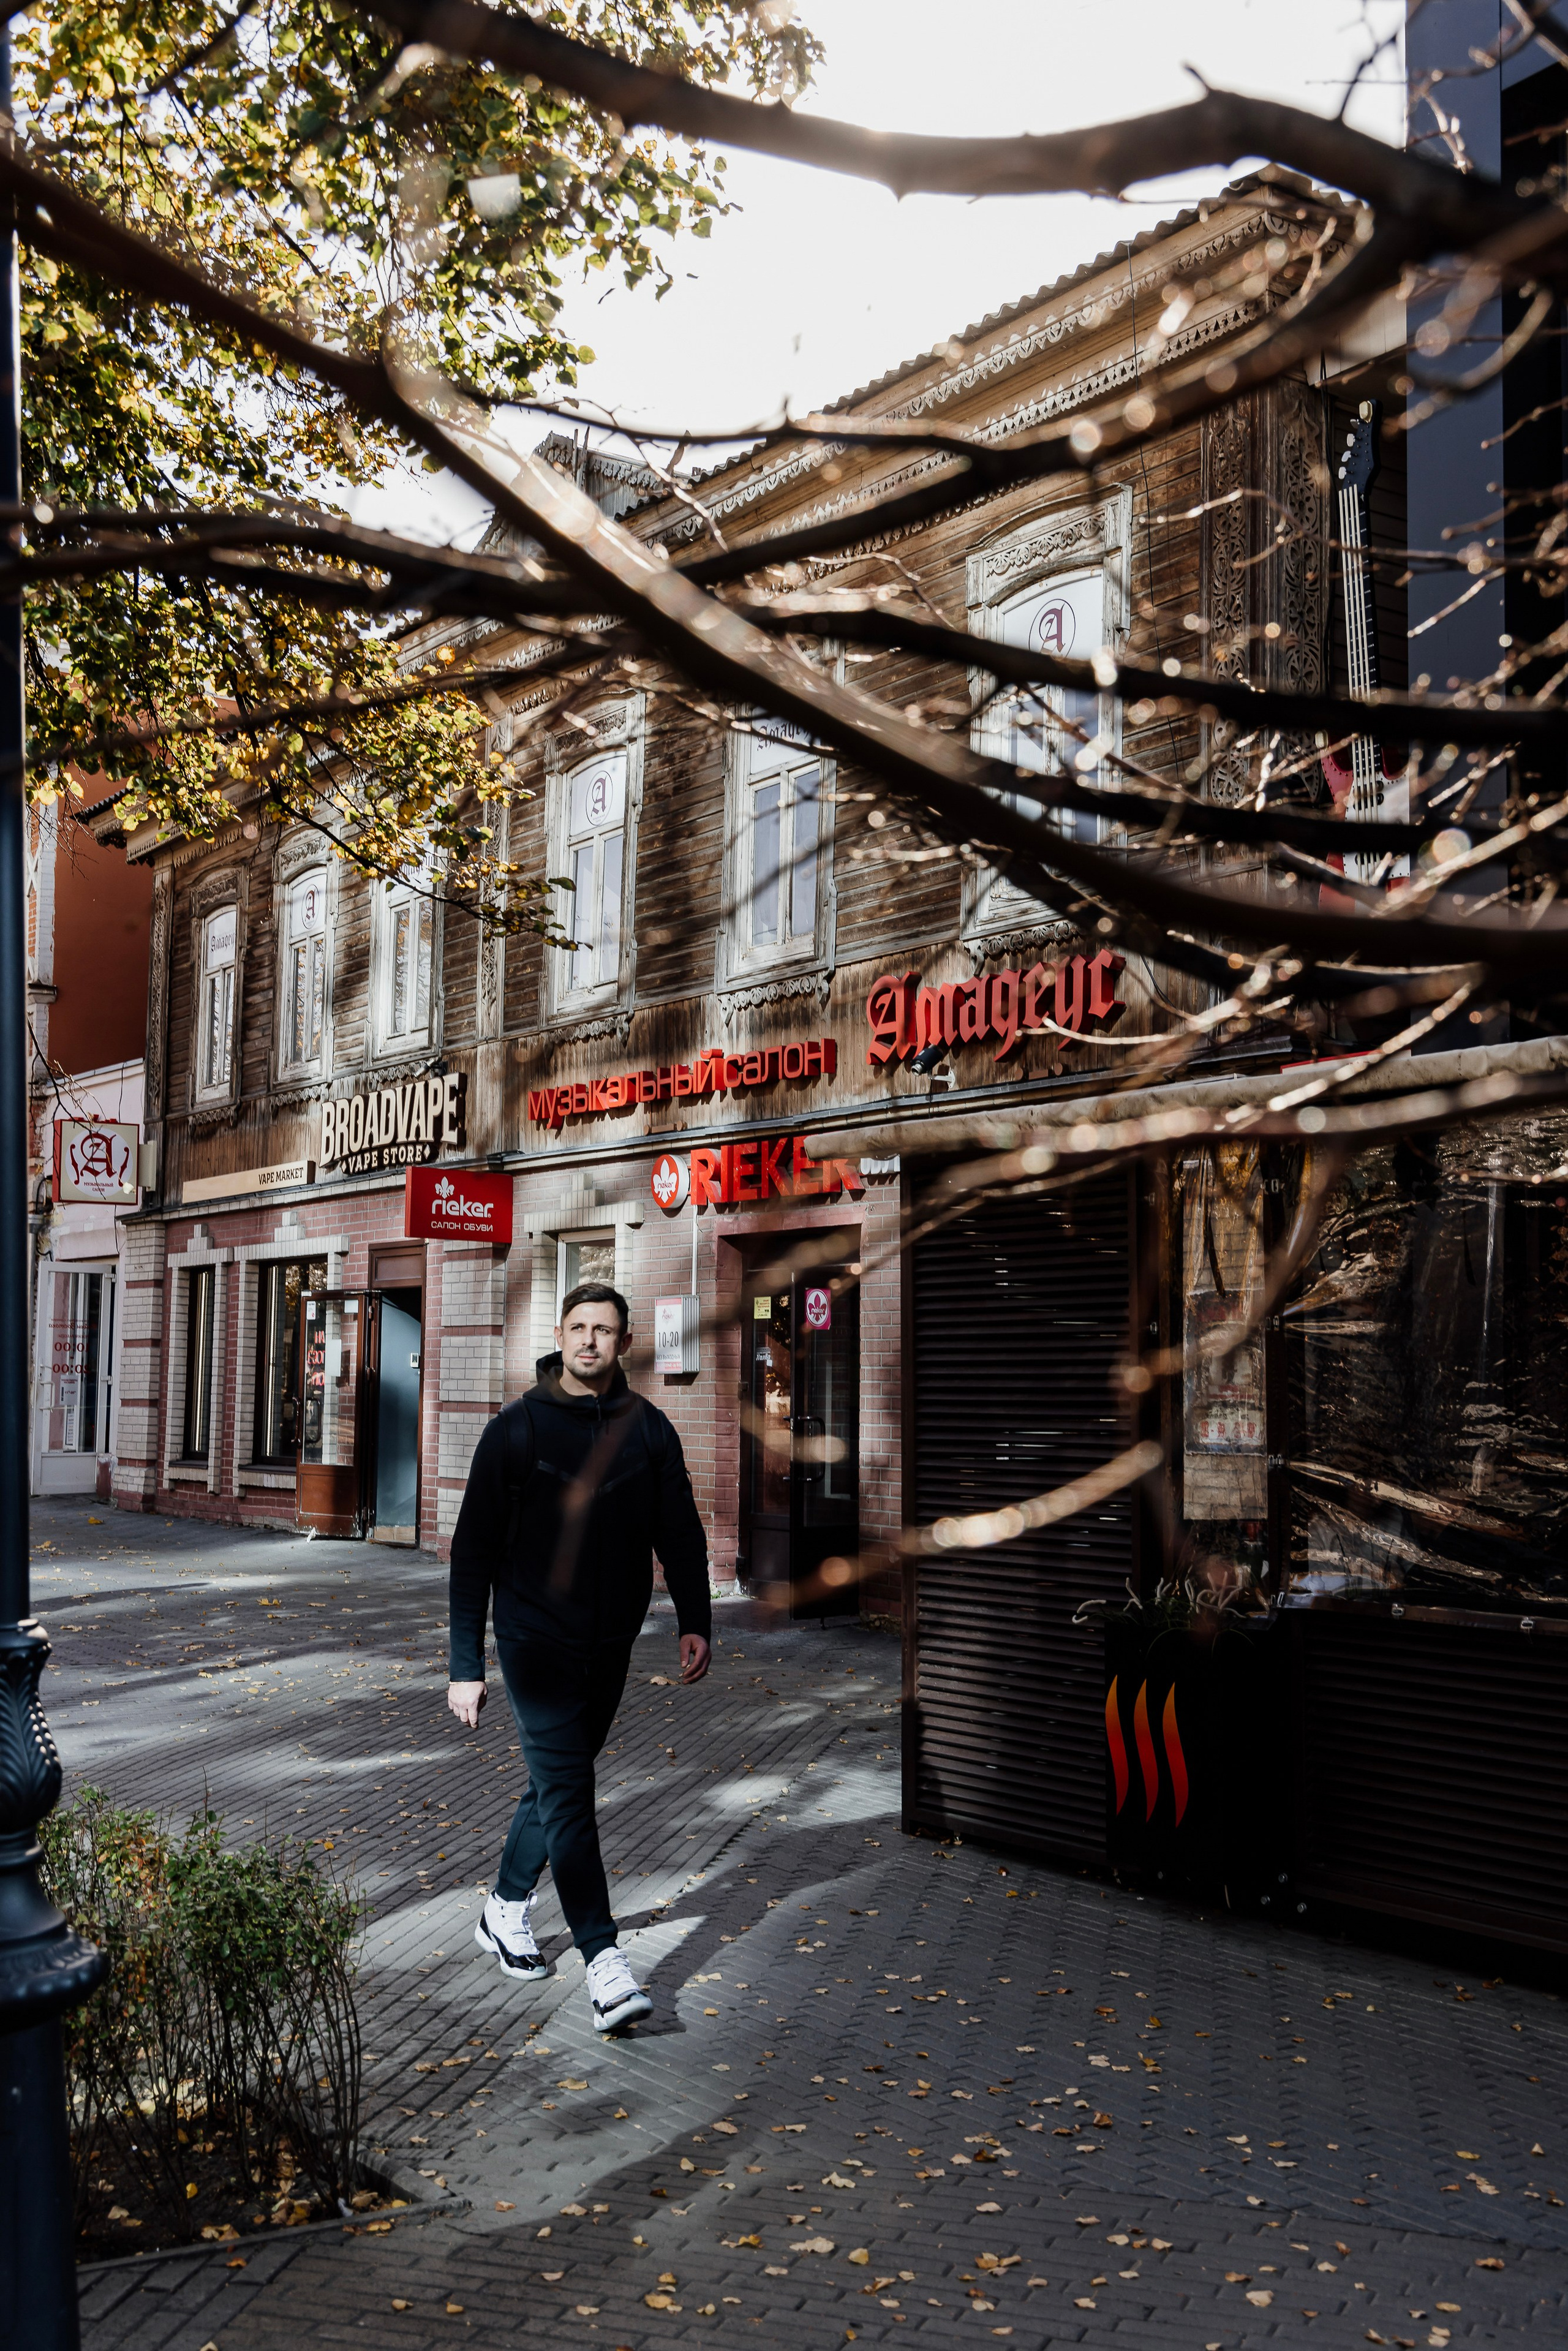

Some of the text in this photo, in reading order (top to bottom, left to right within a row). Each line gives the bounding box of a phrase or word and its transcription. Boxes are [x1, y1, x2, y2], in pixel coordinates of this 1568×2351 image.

[528, 1038, 836, 1130] музыкальный салон
[319, 1073, 459, 1168] BROADVAPE
[348, 1144, 423, 1174] VAPE STORE
[258, 1167, 304, 1185] VAPE MARKET
[657, 1180, 674, 1189] rieker
[431, 1194, 494, 1218] rieker
[431, 1221, 493, 1232] САЛОН ОБУВИ
[658, 1331, 679, 1348] 10-20
